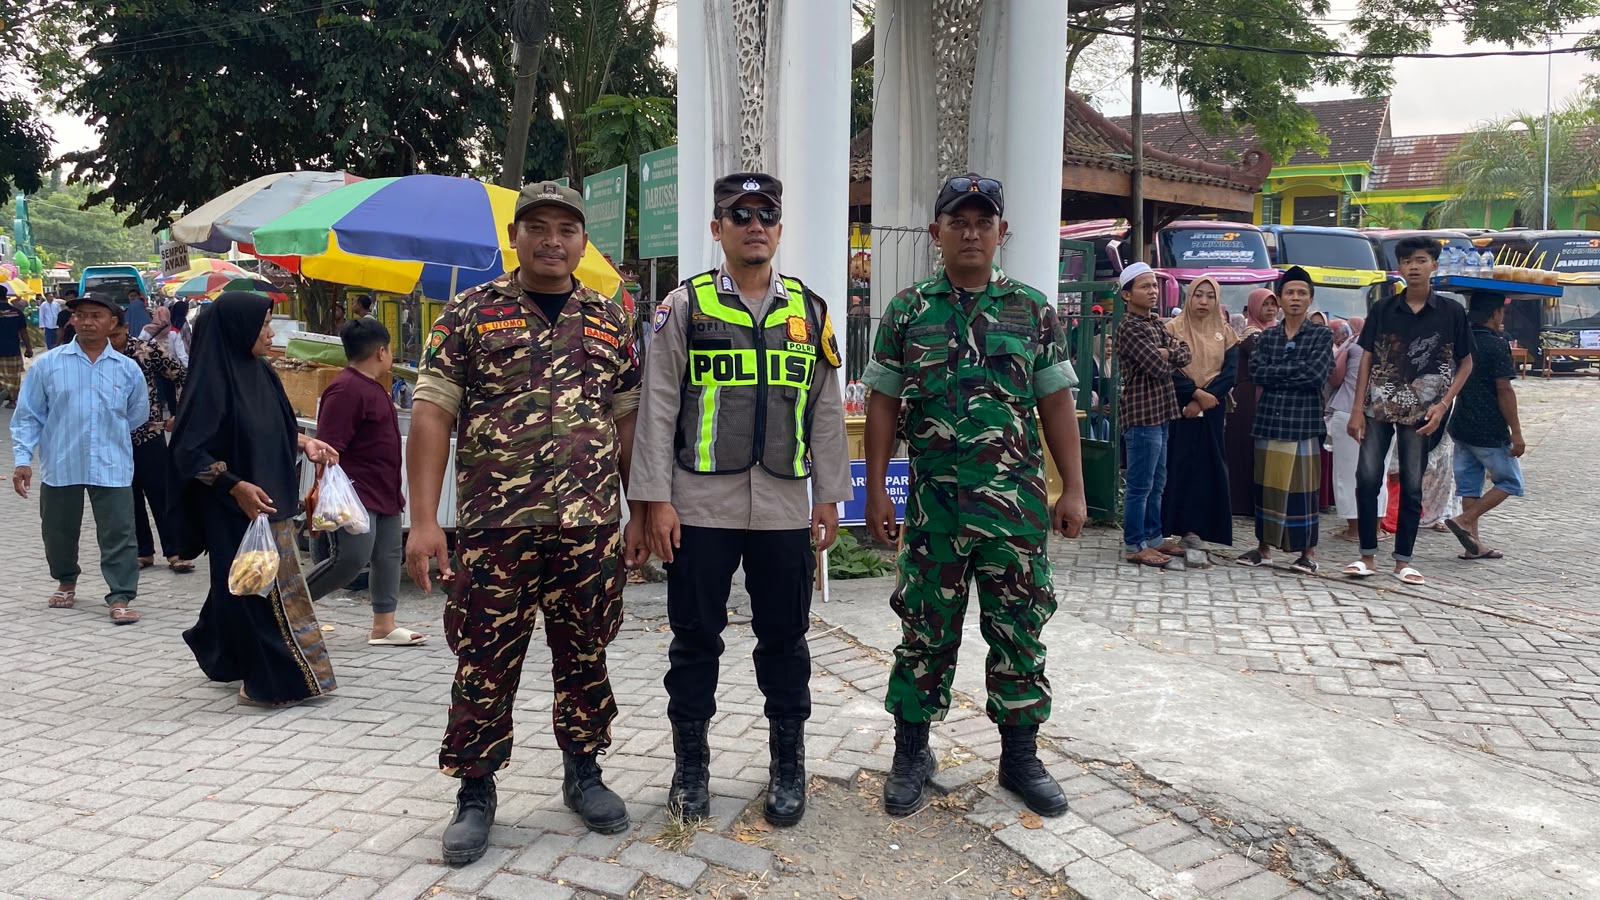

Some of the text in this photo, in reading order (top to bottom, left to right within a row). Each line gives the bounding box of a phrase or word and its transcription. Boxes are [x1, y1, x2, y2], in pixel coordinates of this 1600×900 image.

[161, 245, 187, 259] SEMPOL
[165, 255, 187, 271] AYAM
[492, 319, 523, 329] UTOMO
[586, 326, 618, 348] BANSER
[789, 343, 814, 353] POLRI
